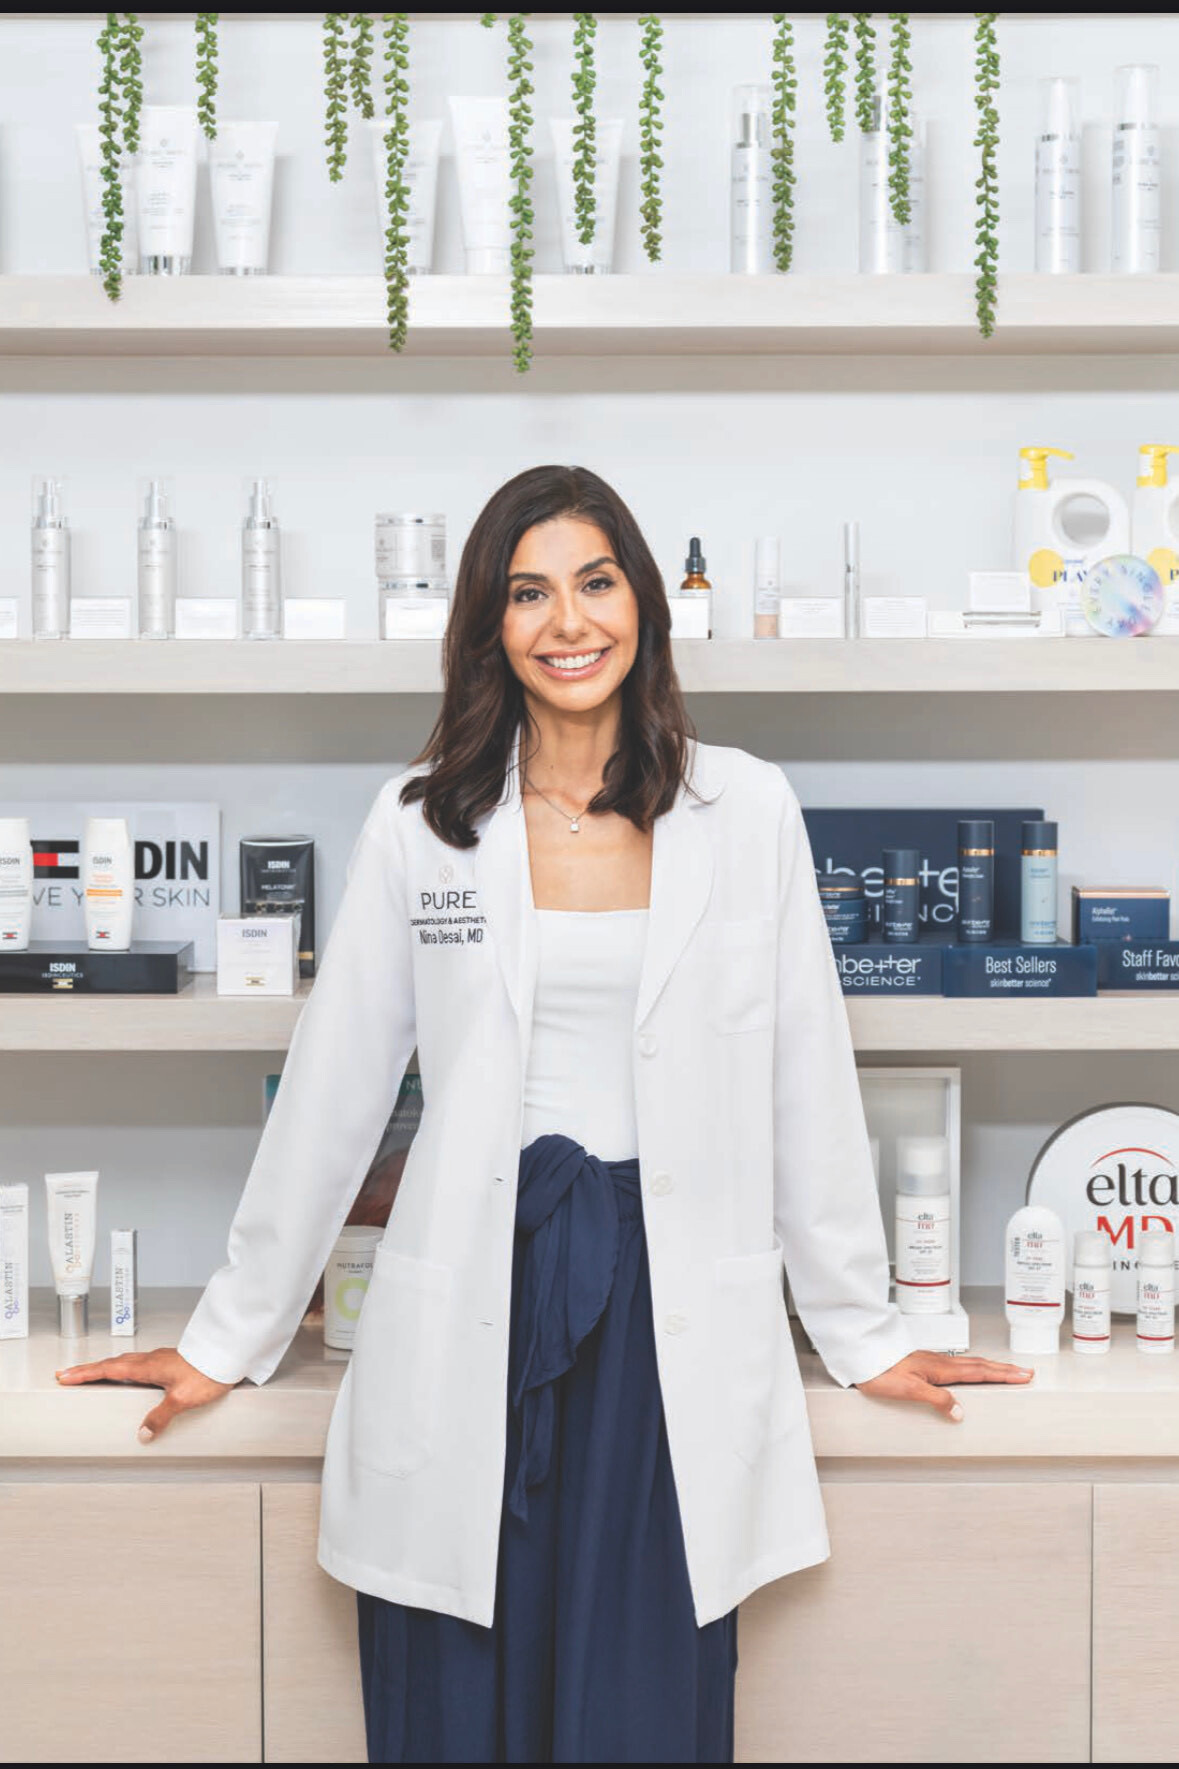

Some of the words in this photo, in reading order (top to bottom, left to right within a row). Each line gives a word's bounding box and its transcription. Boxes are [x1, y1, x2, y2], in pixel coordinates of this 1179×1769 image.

[92, 856, 112, 865] ISDIN
[134, 841, 208, 880] DIN
[268, 861, 290, 869] ISDIN
[33, 887, 62, 906] VE
[152, 887, 210, 907] SKIN
[420, 891, 477, 910] PURE
[242, 928, 267, 938] ISDIN
[419, 928, 437, 945] Nina
[467, 928, 483, 943] MD
[985, 955, 1012, 974] Best
[1015, 955, 1057, 974] Sellers
[1122, 949, 1153, 967] Staff
[49, 963, 76, 972] ISDIN
[1136, 971, 1169, 981] skinbetter
[842, 976, 917, 987] SCIENCE
[990, 978, 1024, 988] skinbetter
[1086, 1163, 1179, 1206] elta
[65, 1213, 74, 1264] ALASTIN
[5, 1262, 13, 1309] ALASTIN
[115, 1268, 124, 1315] ALASTIN
